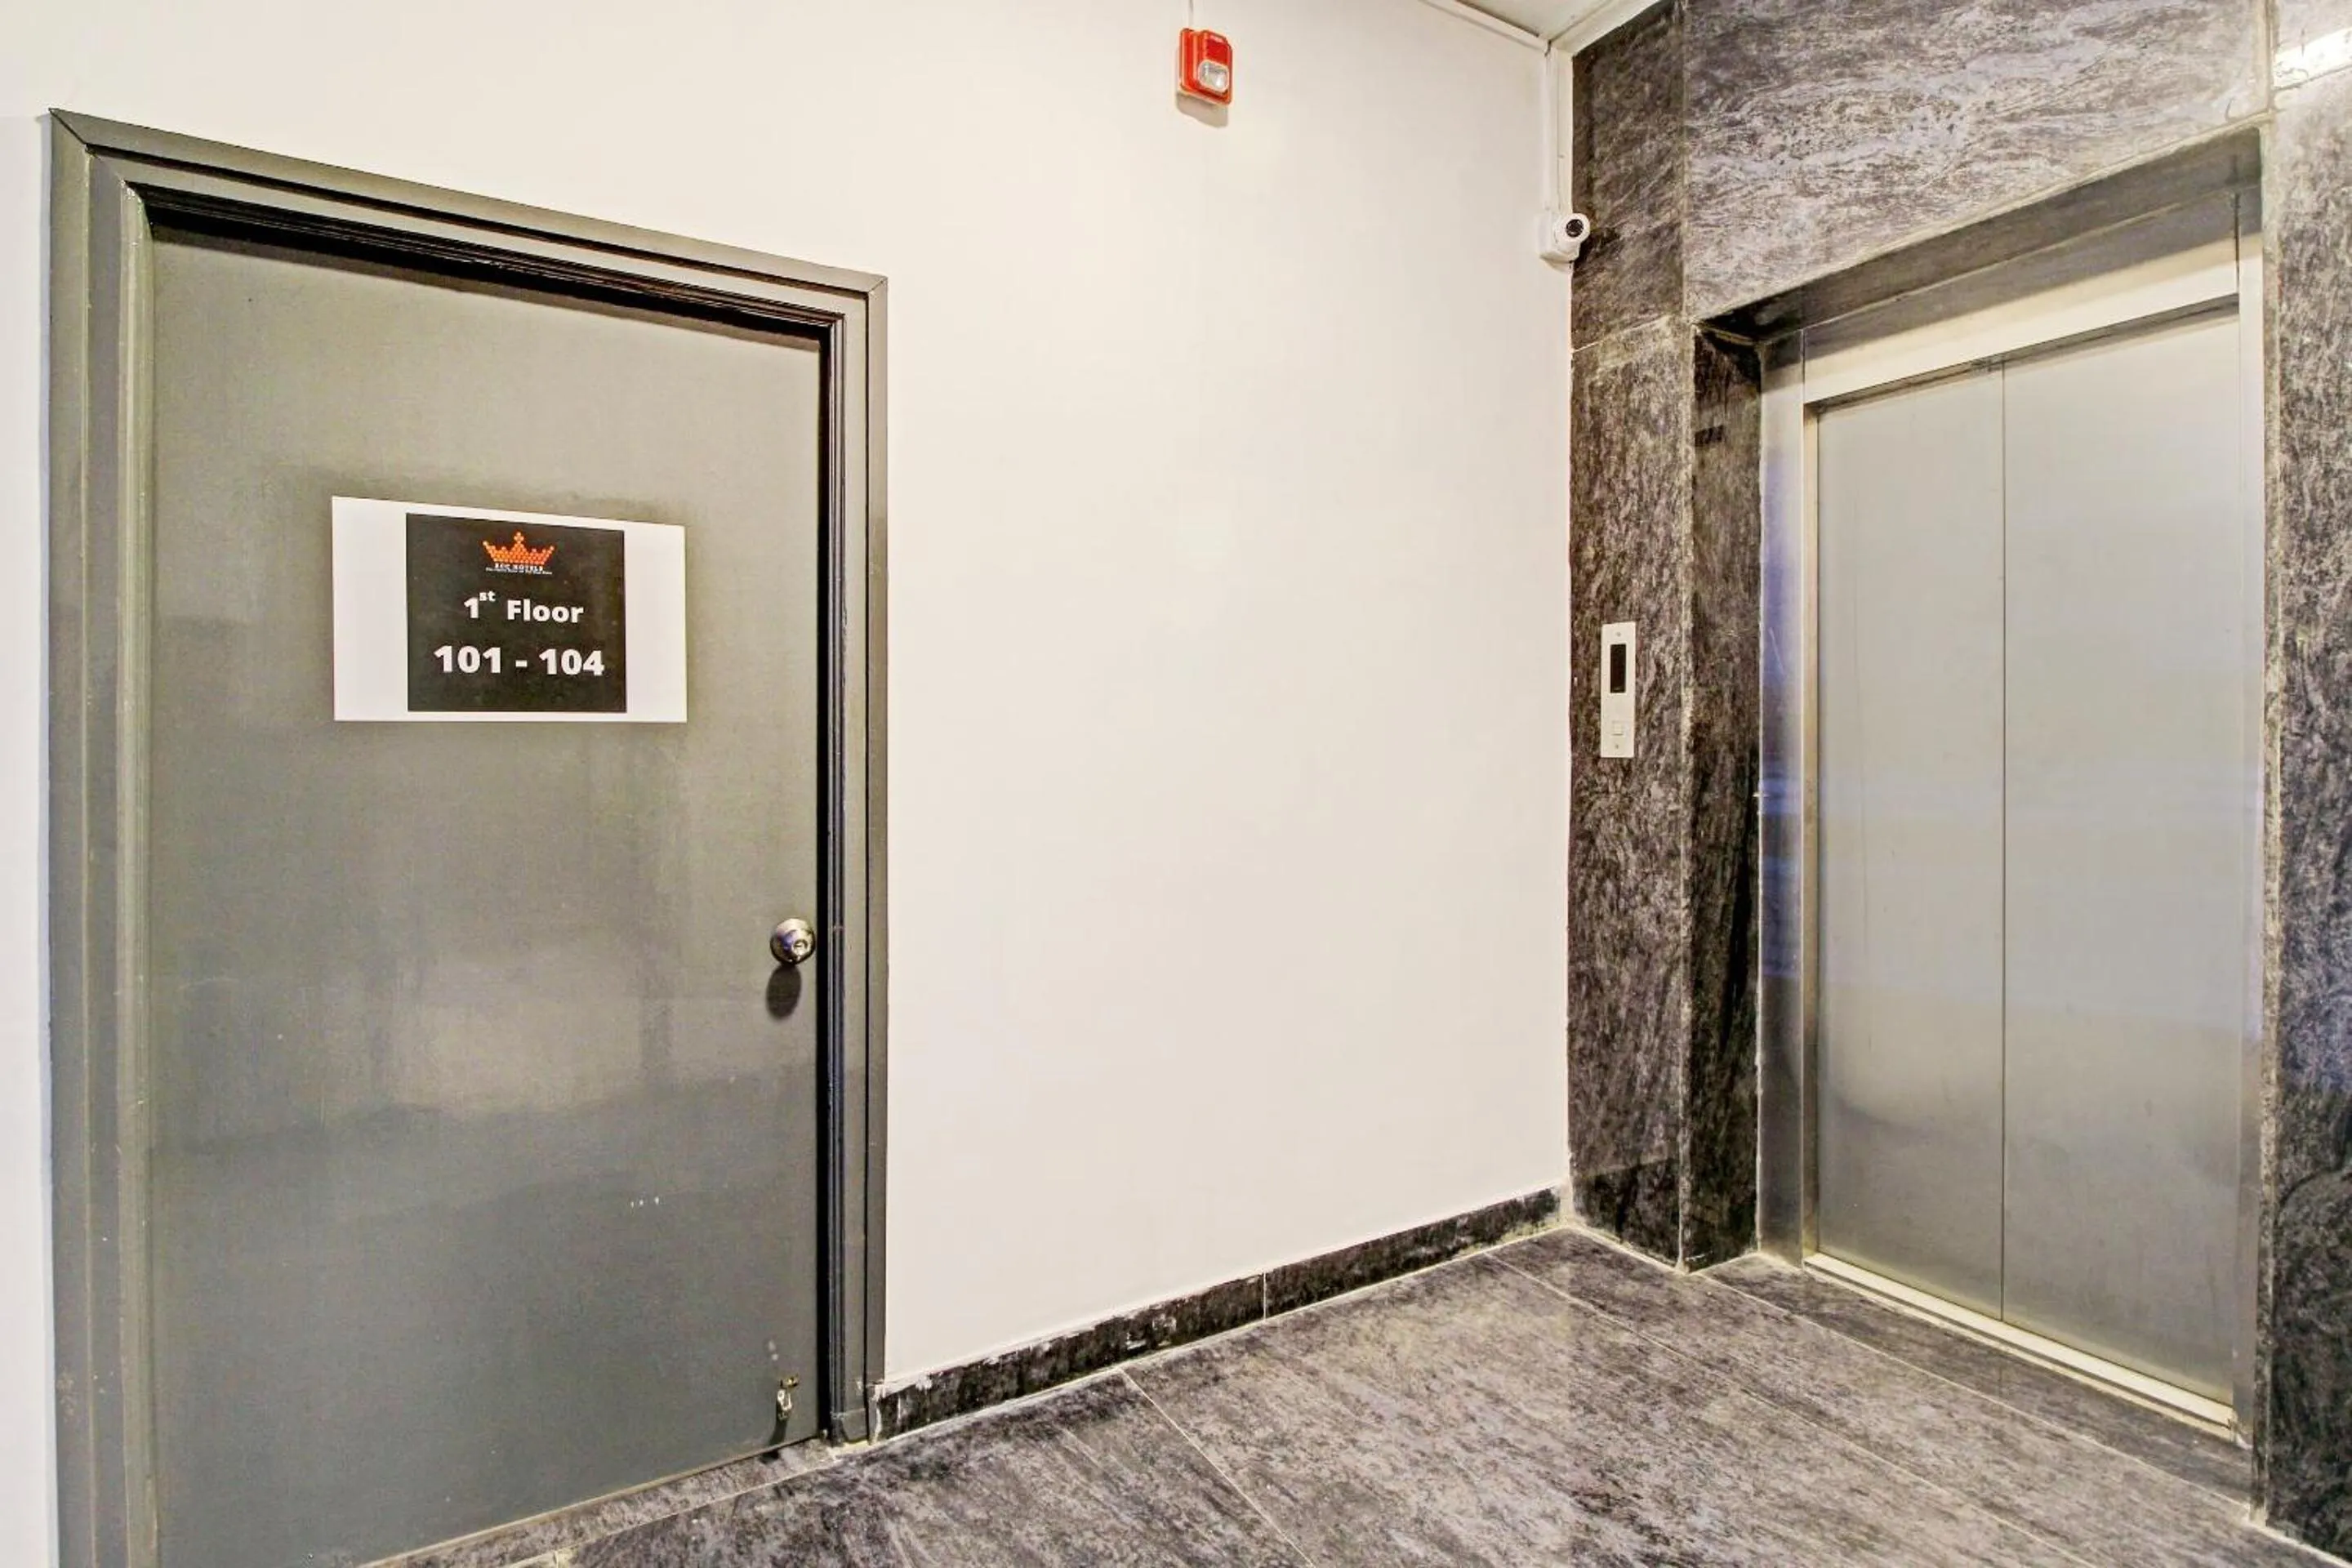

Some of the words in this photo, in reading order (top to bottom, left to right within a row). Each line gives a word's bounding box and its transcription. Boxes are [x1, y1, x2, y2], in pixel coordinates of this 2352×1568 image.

[464, 590, 496, 619] 1st
[506, 599, 584, 623] Floor
[434, 645, 501, 674] 101
[538, 648, 605, 676] 104
